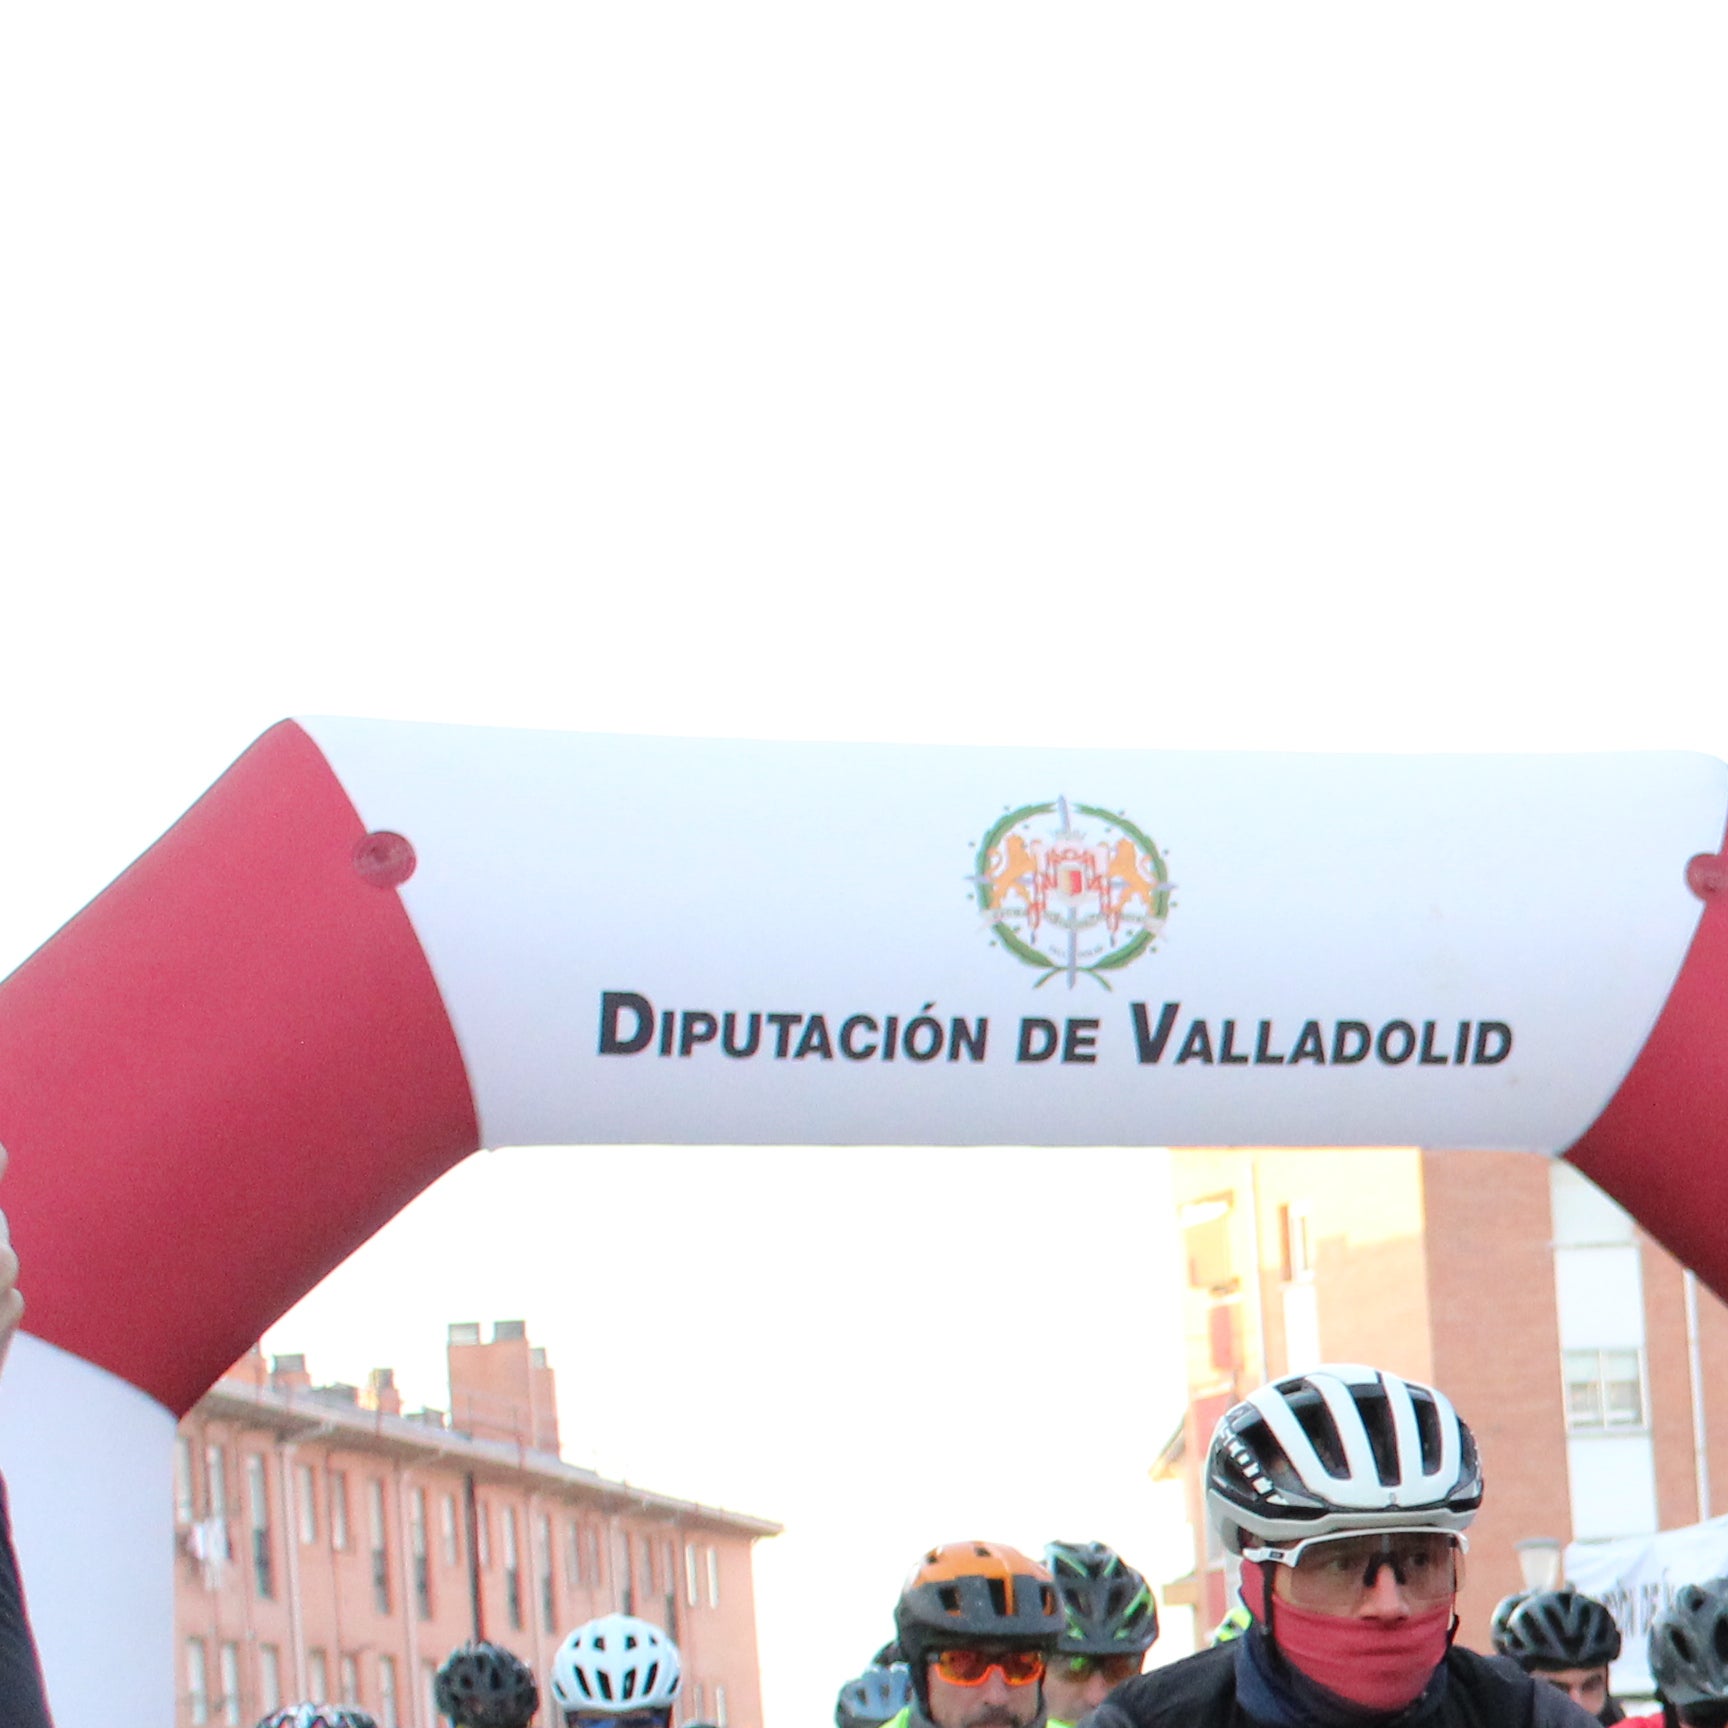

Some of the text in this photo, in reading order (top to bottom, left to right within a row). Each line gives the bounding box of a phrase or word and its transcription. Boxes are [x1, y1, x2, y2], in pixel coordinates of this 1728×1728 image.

[600, 990, 1514, 1067] DIPUTACIÓN DE VALLADOLID
